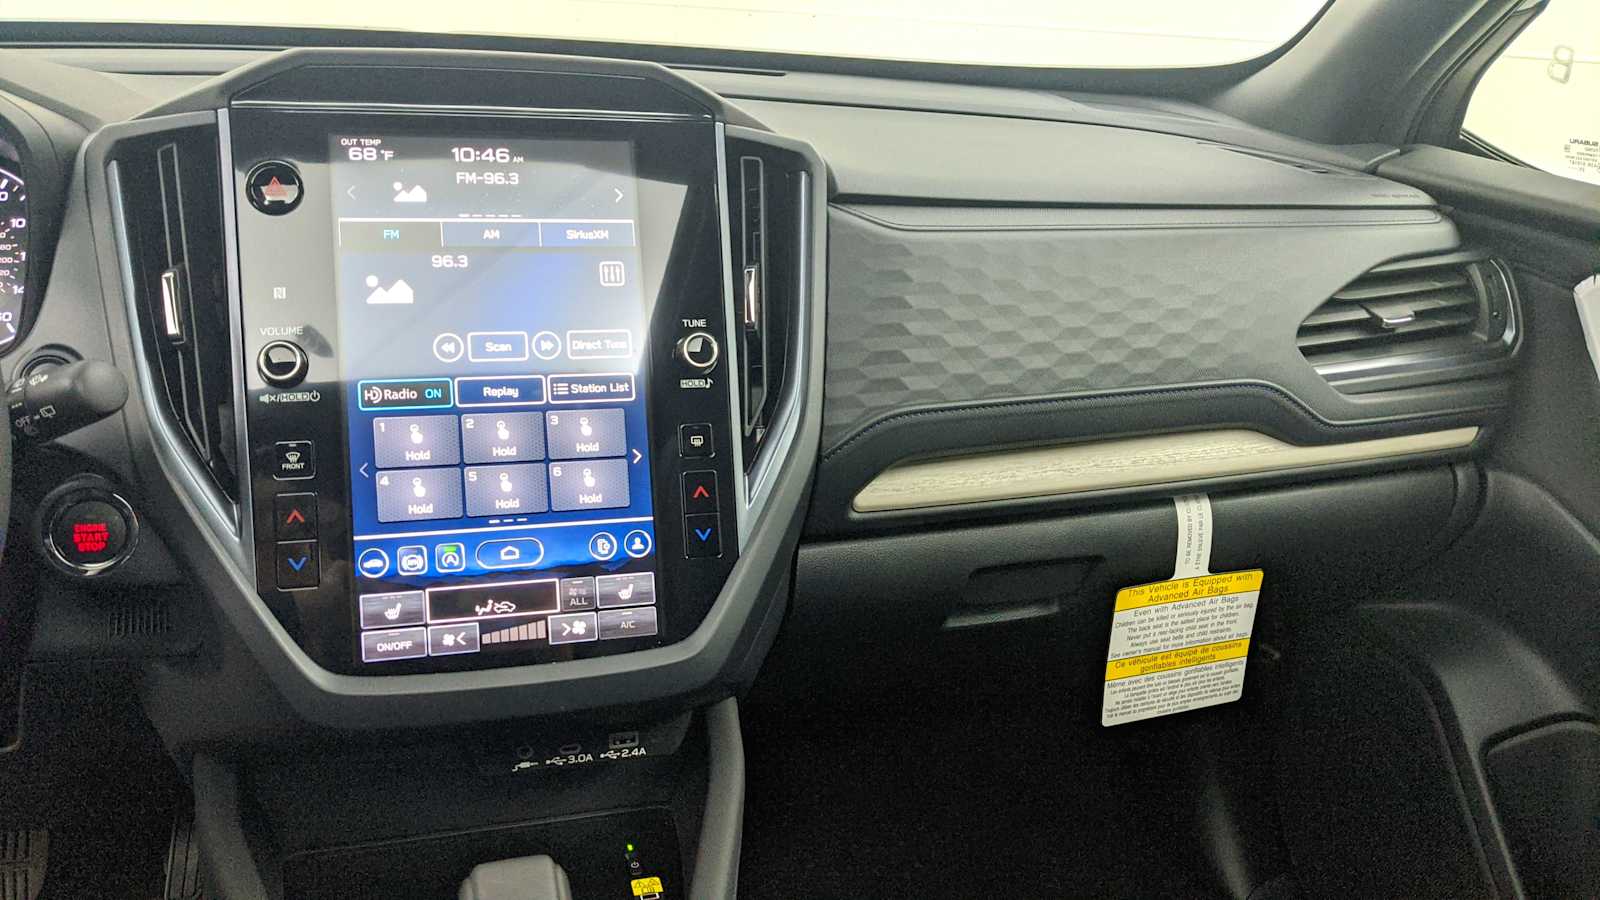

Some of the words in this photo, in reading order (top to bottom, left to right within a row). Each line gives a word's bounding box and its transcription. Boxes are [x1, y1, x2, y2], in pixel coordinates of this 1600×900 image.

[340, 138, 358, 146] OUT
[360, 138, 381, 146] TEMP
[349, 147, 377, 161] 68
[451, 147, 510, 162] 10:46
[456, 172, 519, 184] FM-96.3
[383, 229, 400, 239] FM
[483, 230, 500, 239] AM
[566, 229, 609, 240] SiriusXM
[431, 255, 468, 268] 96.3
[682, 319, 707, 328] TUNE
[260, 326, 304, 336] VOLUME
[485, 342, 512, 352] Scan
[572, 340, 602, 350] Direct
[570, 383, 607, 394] Station
[609, 382, 630, 392] List
[681, 379, 706, 388] HOLD
[281, 392, 309, 402] HOLD
[384, 388, 418, 400] Radio
[425, 388, 442, 399] ON
[483, 386, 519, 398] Replay
[465, 419, 475, 429] 2
[550, 415, 559, 425] 3
[380, 422, 386, 432] 1
[492, 446, 517, 457] Hold
[576, 442, 600, 453] Hold
[405, 450, 431, 461] Hold
[468, 472, 478, 482] 5
[552, 467, 562, 477] 6
[380, 476, 389, 486] 4
[495, 498, 520, 509] Hold
[579, 493, 602, 504] Hold
[408, 504, 433, 515] Hold
[73, 532, 109, 544] START
[78, 542, 106, 552] STOP
[1128, 589, 1145, 598] This
[1149, 583, 1179, 593] Vehicle
[1193, 576, 1232, 587] Equipped
[1236, 573, 1253, 581] with
[1148, 592, 1189, 603] Advanced
[1208, 585, 1229, 594] Bags
[569, 597, 588, 606] ALL
[1134, 609, 1151, 618] Even
[1154, 606, 1169, 614] with
[1172, 601, 1206, 611] Advanced
[1221, 596, 1239, 604] Bags
[621, 620, 636, 629] A/C
[376, 639, 413, 652] ON/OFF
[1114, 660, 1126, 669] Ce
[1160, 652, 1173, 661] est
[1199, 646, 1210, 654] de
[621, 748, 647, 757] 2.4A
[568, 754, 593, 764] 3.0A
